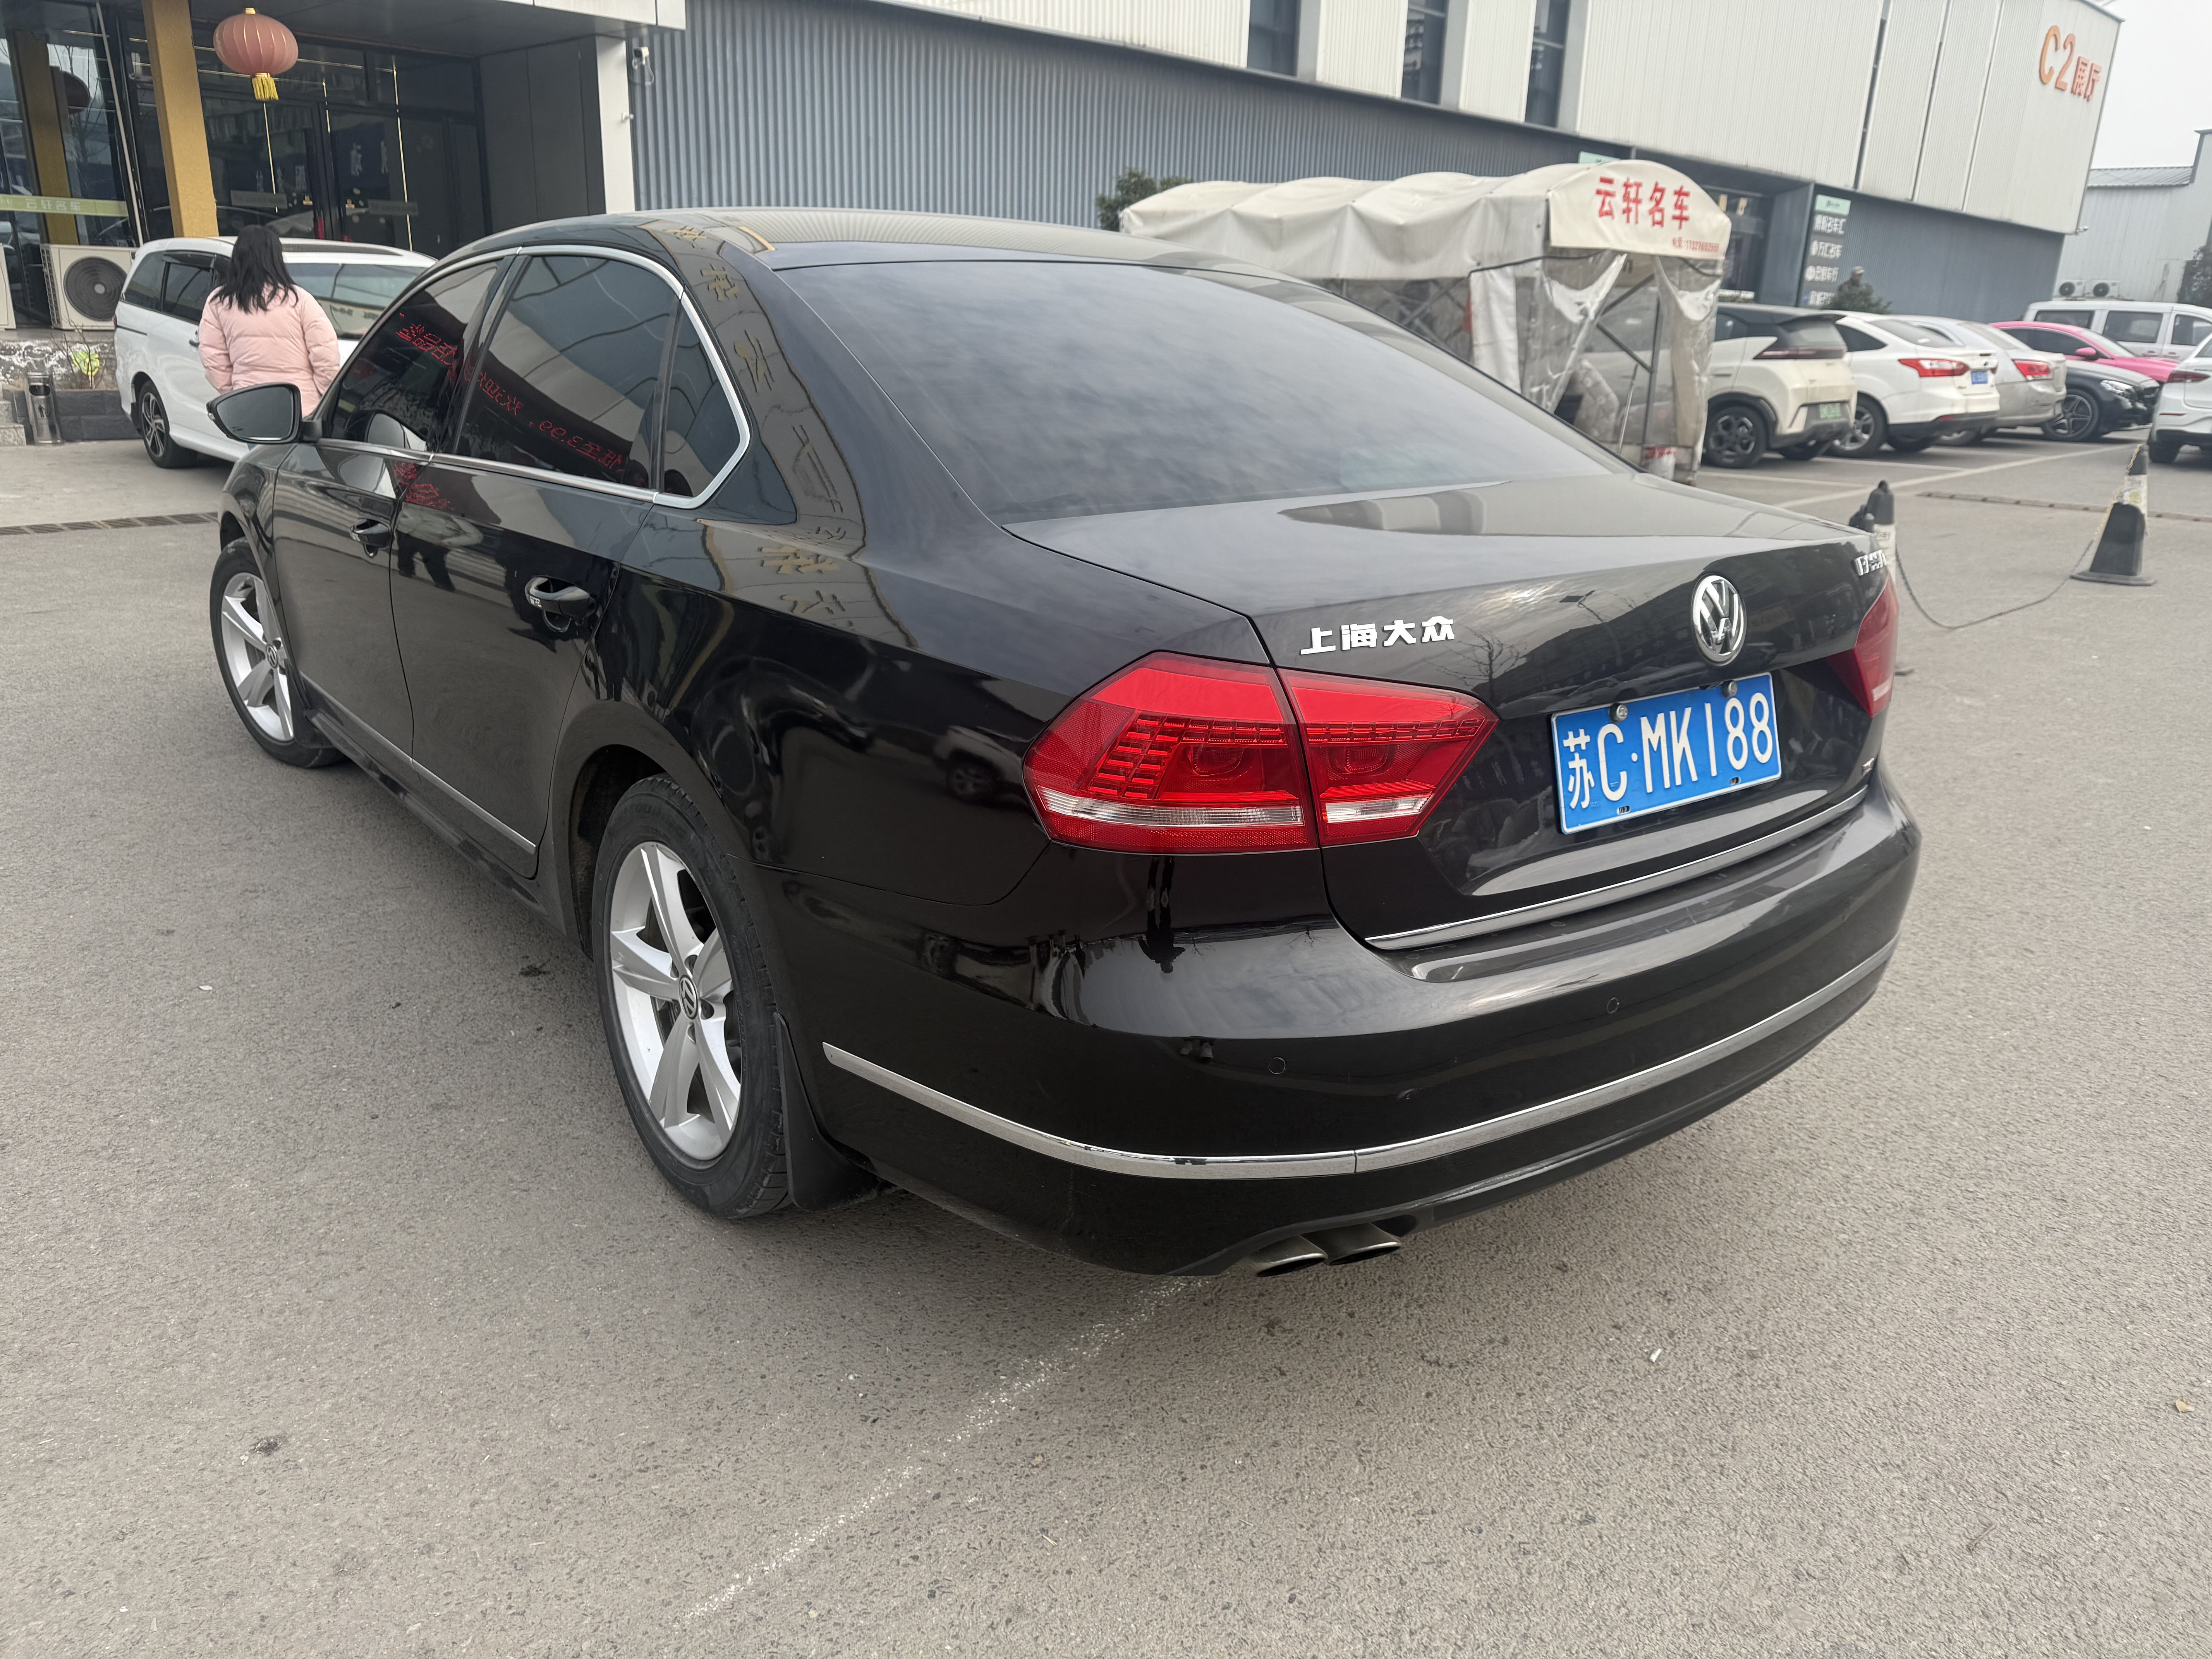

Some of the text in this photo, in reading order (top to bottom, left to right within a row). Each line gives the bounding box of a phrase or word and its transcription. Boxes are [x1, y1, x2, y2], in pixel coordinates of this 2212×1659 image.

[2039, 25, 2102, 102] C2展厅
[1596, 177, 1690, 230] 云轩名车
[1300, 616, 1455, 656] 上海大众
[1563, 692, 1773, 809] 苏C·MK188
